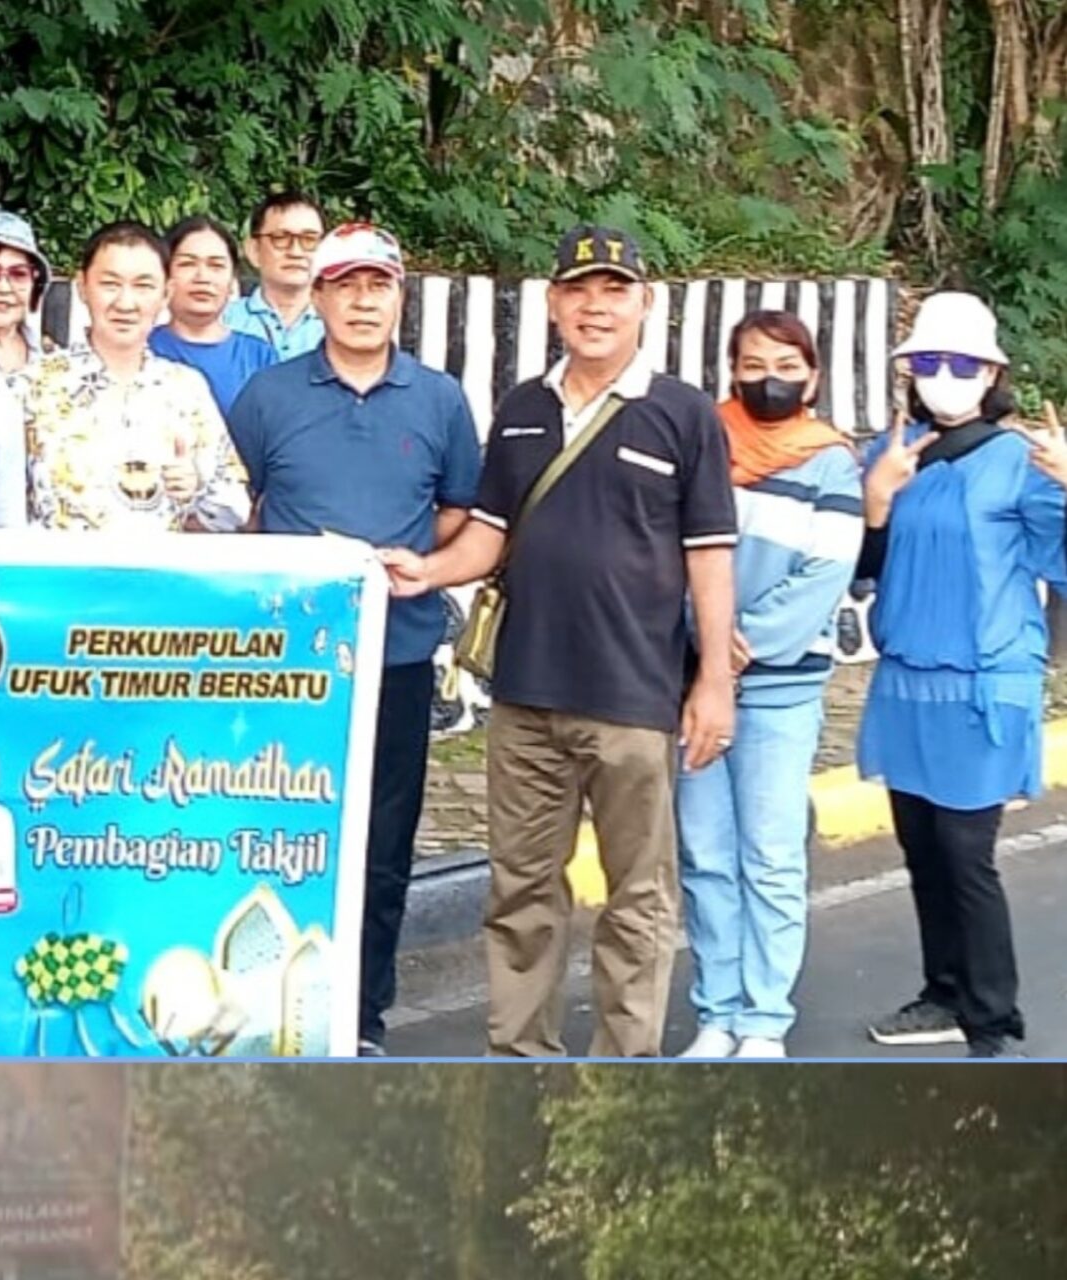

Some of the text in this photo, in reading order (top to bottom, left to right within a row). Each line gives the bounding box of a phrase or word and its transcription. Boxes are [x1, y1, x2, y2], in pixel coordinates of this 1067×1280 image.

[67, 628, 284, 659] PERKUMPULAN
[9, 667, 328, 700] UFUK TIMUR BERSATU
[24, 737, 336, 808] Safari Ramadhan
[27, 823, 328, 886] Pembagian Takjil
